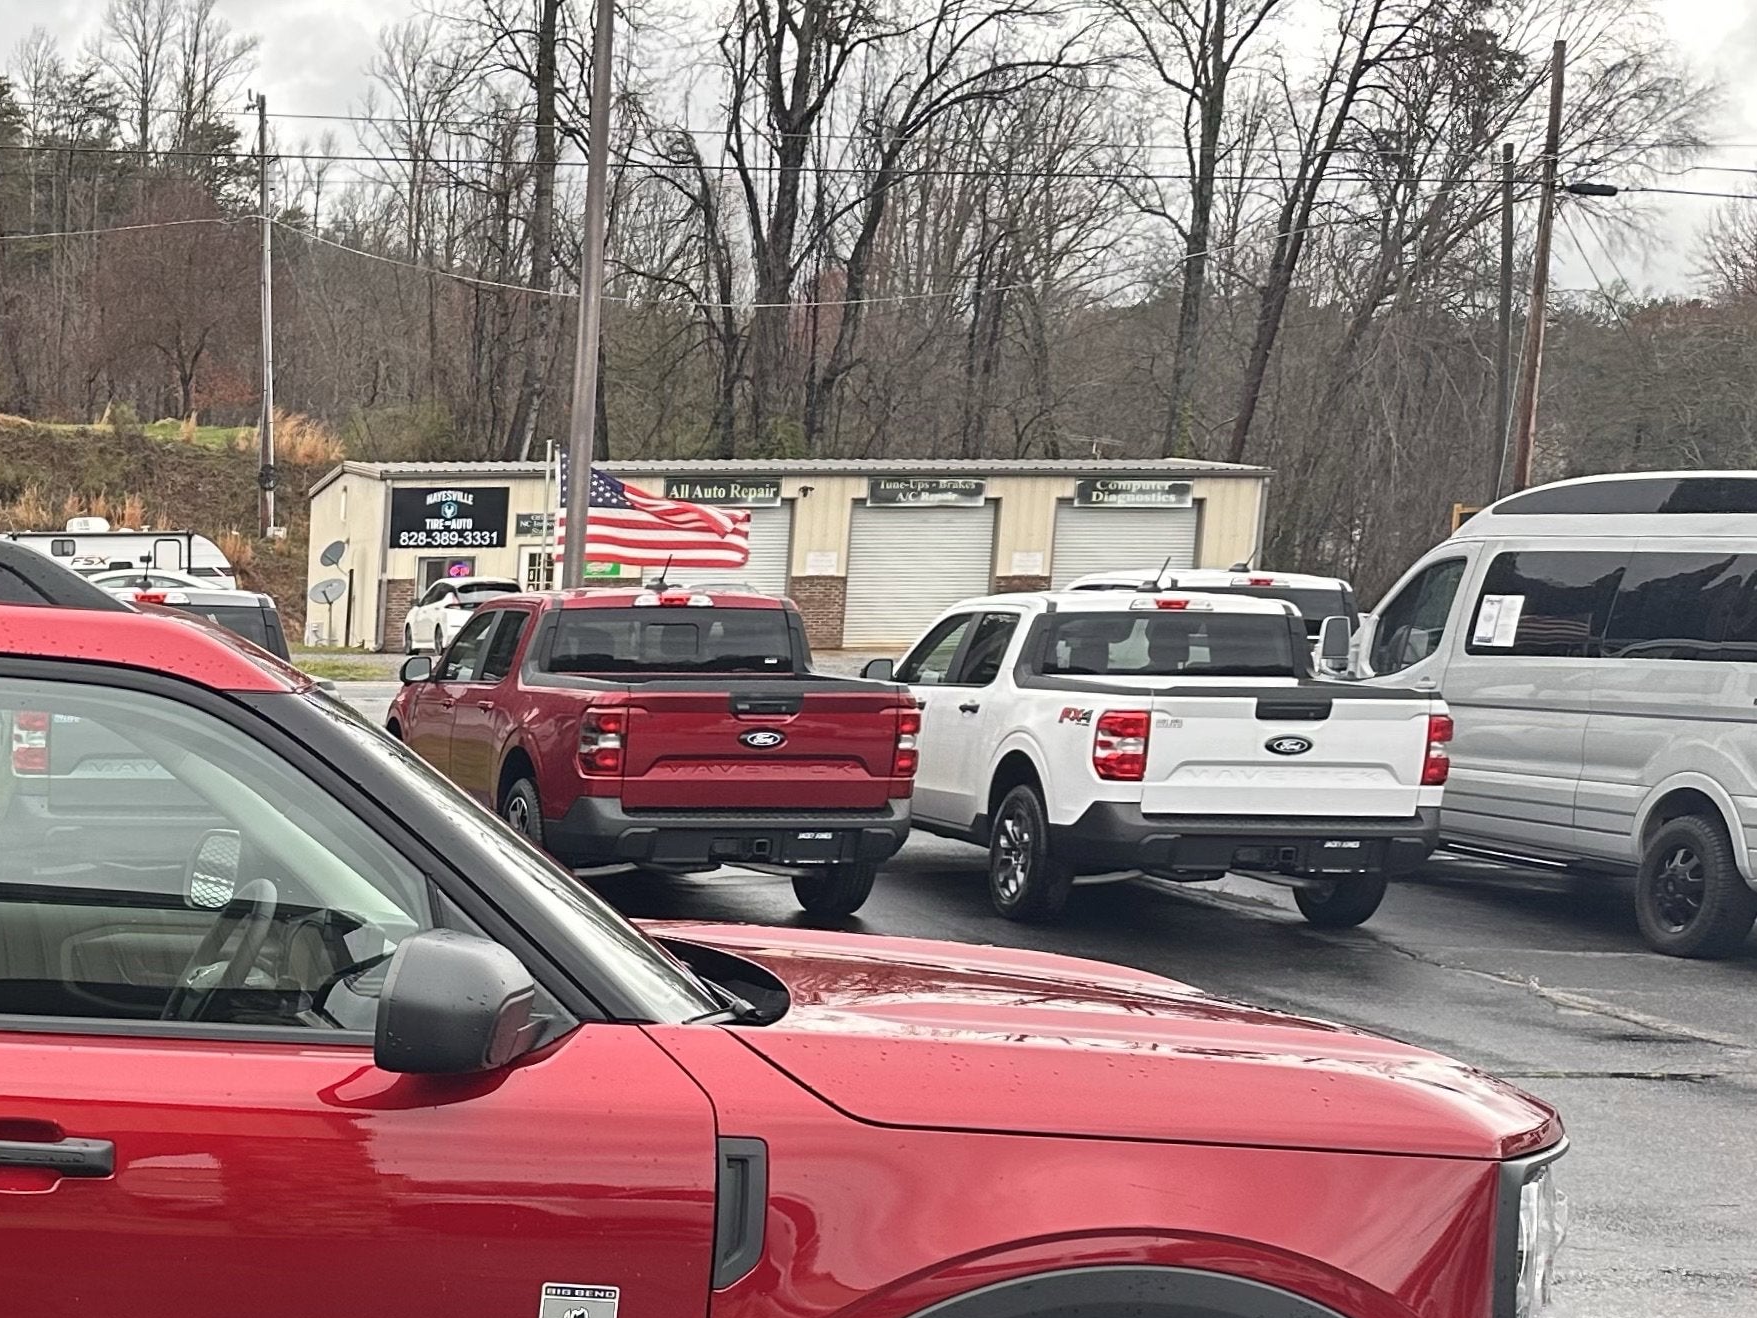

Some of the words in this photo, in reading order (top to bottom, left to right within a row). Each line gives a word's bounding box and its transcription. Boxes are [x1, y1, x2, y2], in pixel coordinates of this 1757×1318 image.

[880, 480, 930, 491] Tune-Ups
[1095, 480, 1171, 492] Computer
[426, 490, 474, 506] HAYESVILLE
[667, 484, 690, 499] All
[691, 484, 726, 499] Auto
[729, 483, 778, 502] Repair
[895, 491, 918, 502] A/C
[1091, 491, 1177, 504] Diagnostics
[425, 518, 445, 530] TIRE
[450, 518, 473, 530] AUTO
[399, 531, 498, 546] 828-389-3331
[70, 555, 112, 567] FSX
[1057, 707, 1094, 723] FX4
[546, 1287, 572, 1296] BIG
[574, 1289, 616, 1299] BEND
